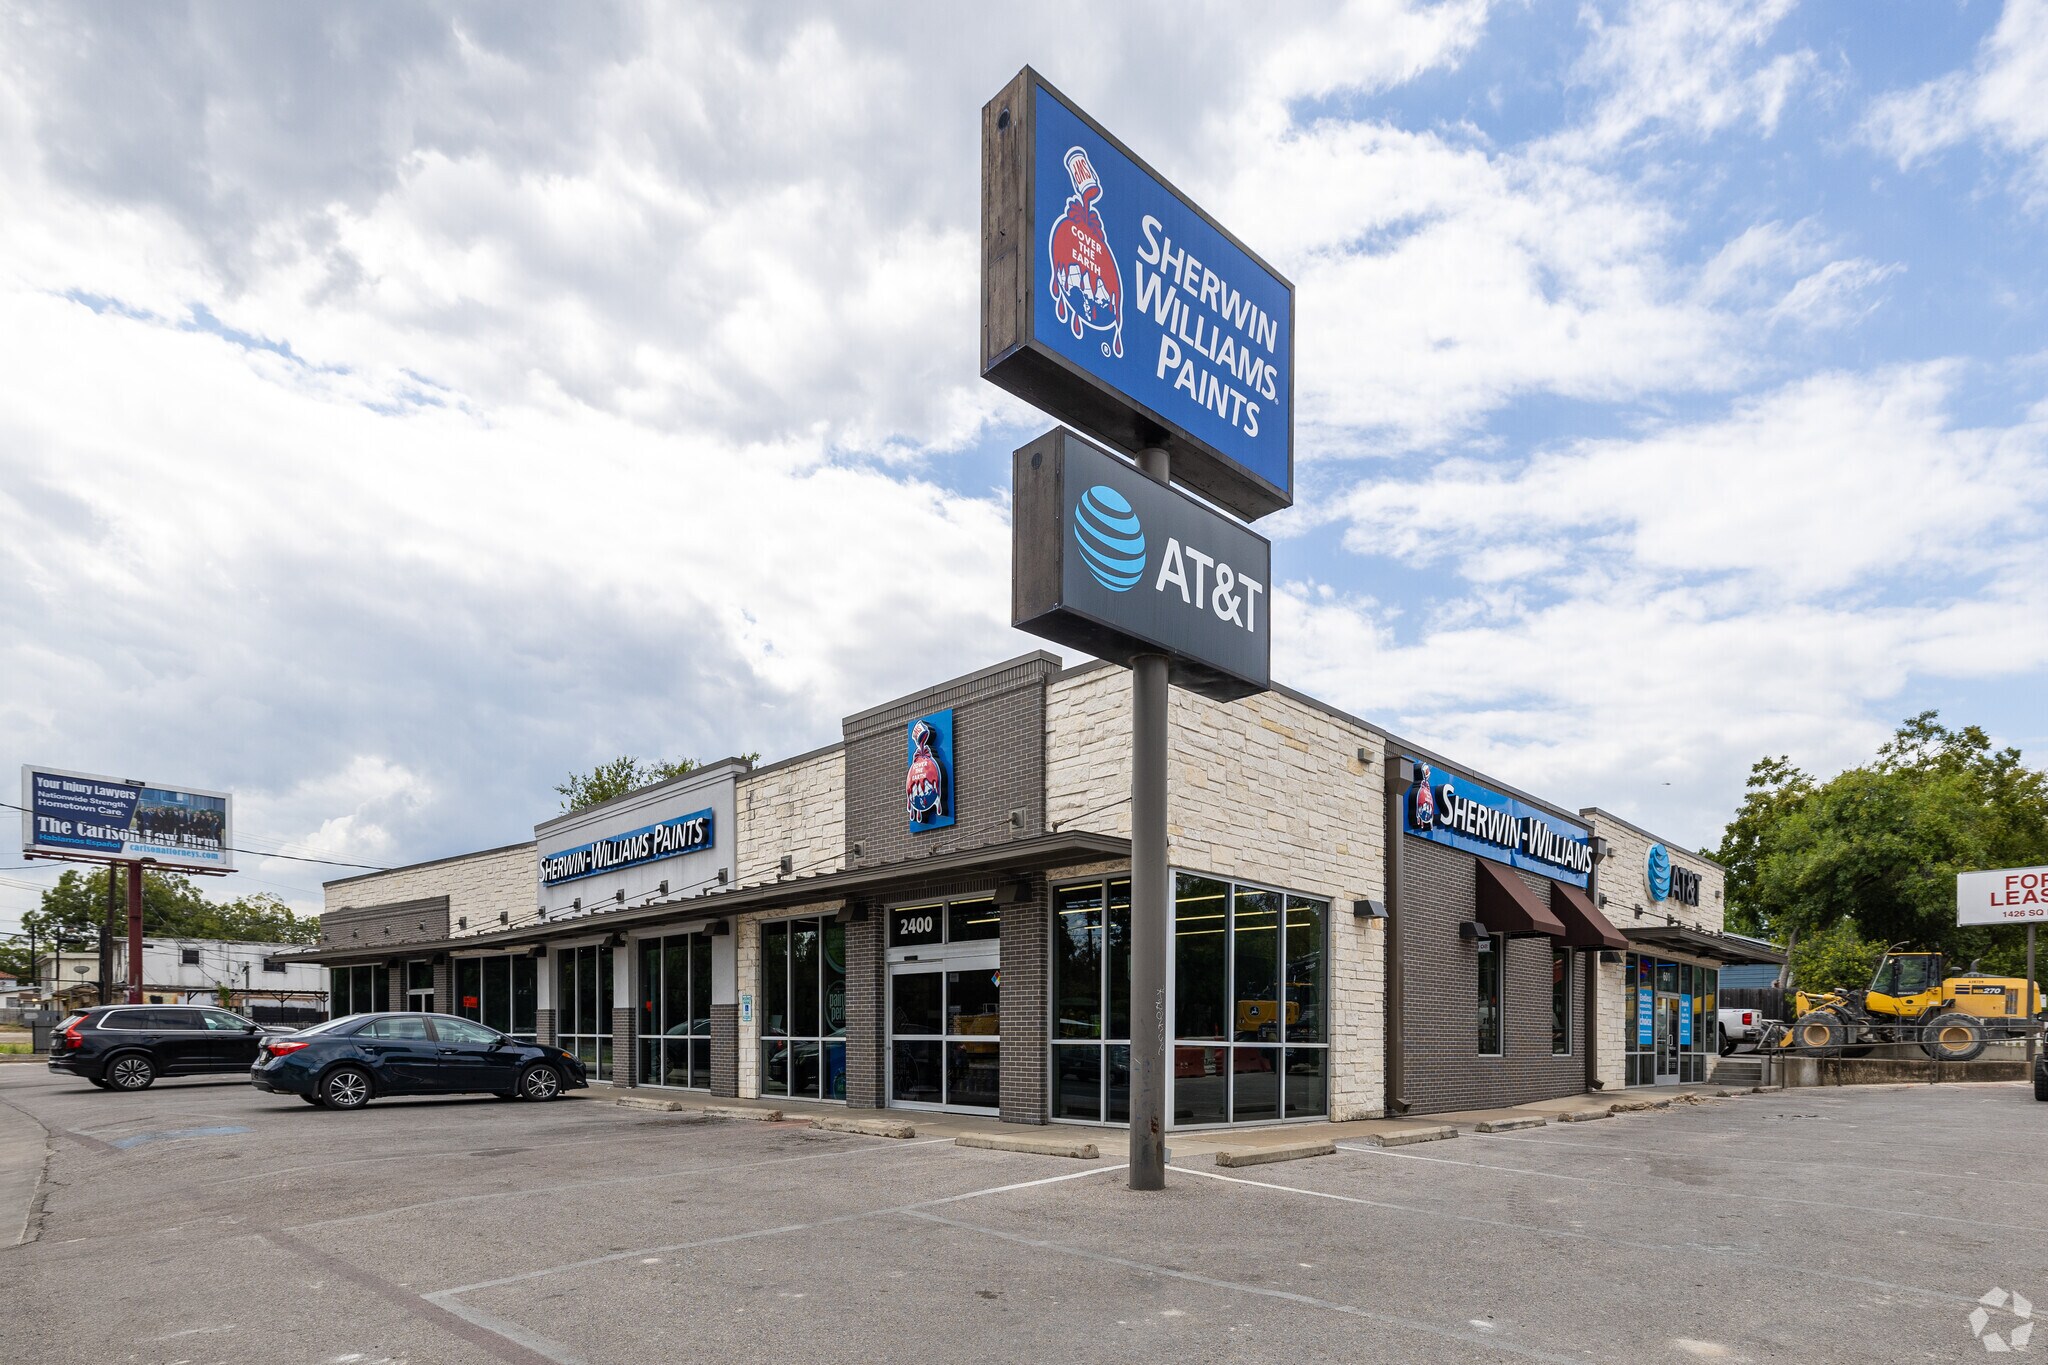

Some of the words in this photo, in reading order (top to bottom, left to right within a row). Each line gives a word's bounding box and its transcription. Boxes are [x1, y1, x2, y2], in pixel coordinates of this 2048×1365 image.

[1071, 225, 1102, 255] COVER
[1078, 241, 1095, 260] THE
[1072, 248, 1101, 276] EARTH
[1137, 214, 1278, 353] SHERWIN
[1135, 259, 1279, 402] WILLIAMS
[1156, 333, 1260, 438] PAINTS
[1155, 537, 1263, 633] AT&T
[36, 777, 61, 789] Your
[63, 781, 93, 795] Injury
[94, 785, 136, 799] Lawyers
[37, 791, 88, 803] Nationwide
[89, 797, 129, 809] Strength.
[38, 799, 96, 812] Hometown
[97, 806, 125, 816] Care.
[37, 816, 72, 835] The
[143, 829, 178, 847] Law
[182, 833, 219, 851] Firm
[85, 837, 120, 849] Español
[1440, 783, 1593, 874] SHERWIN-WILLIAMS
[538, 832, 650, 883] SHERWIN-WILLIAMS
[653, 817, 704, 854] PAINTS
[1669, 865, 1702, 907] AT&T
[900, 916, 933, 935] 2400
[2003, 910, 2026, 918] 1426
[2028, 909, 2044, 917] SQ
